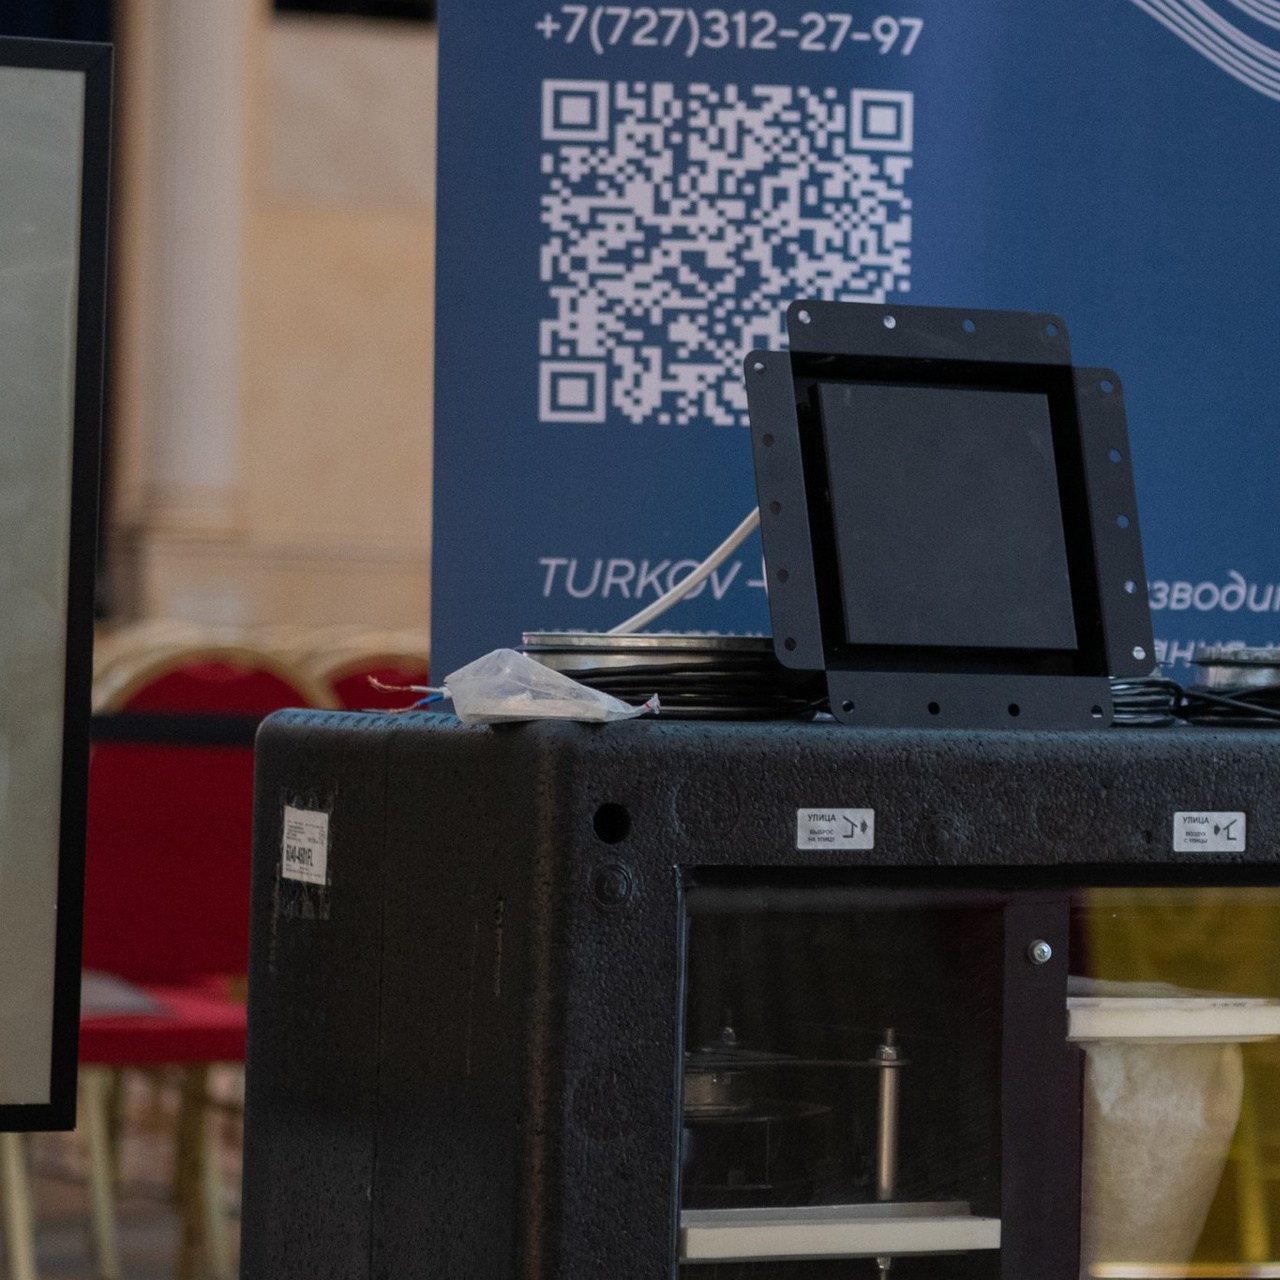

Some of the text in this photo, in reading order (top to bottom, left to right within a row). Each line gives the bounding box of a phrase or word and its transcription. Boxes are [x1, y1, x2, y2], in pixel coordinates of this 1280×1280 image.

[536, 4, 925, 57] +7(727)312-27-97
[807, 813, 837, 823] УЛИЦА
[1182, 816, 1210, 825] УЛИЦА
